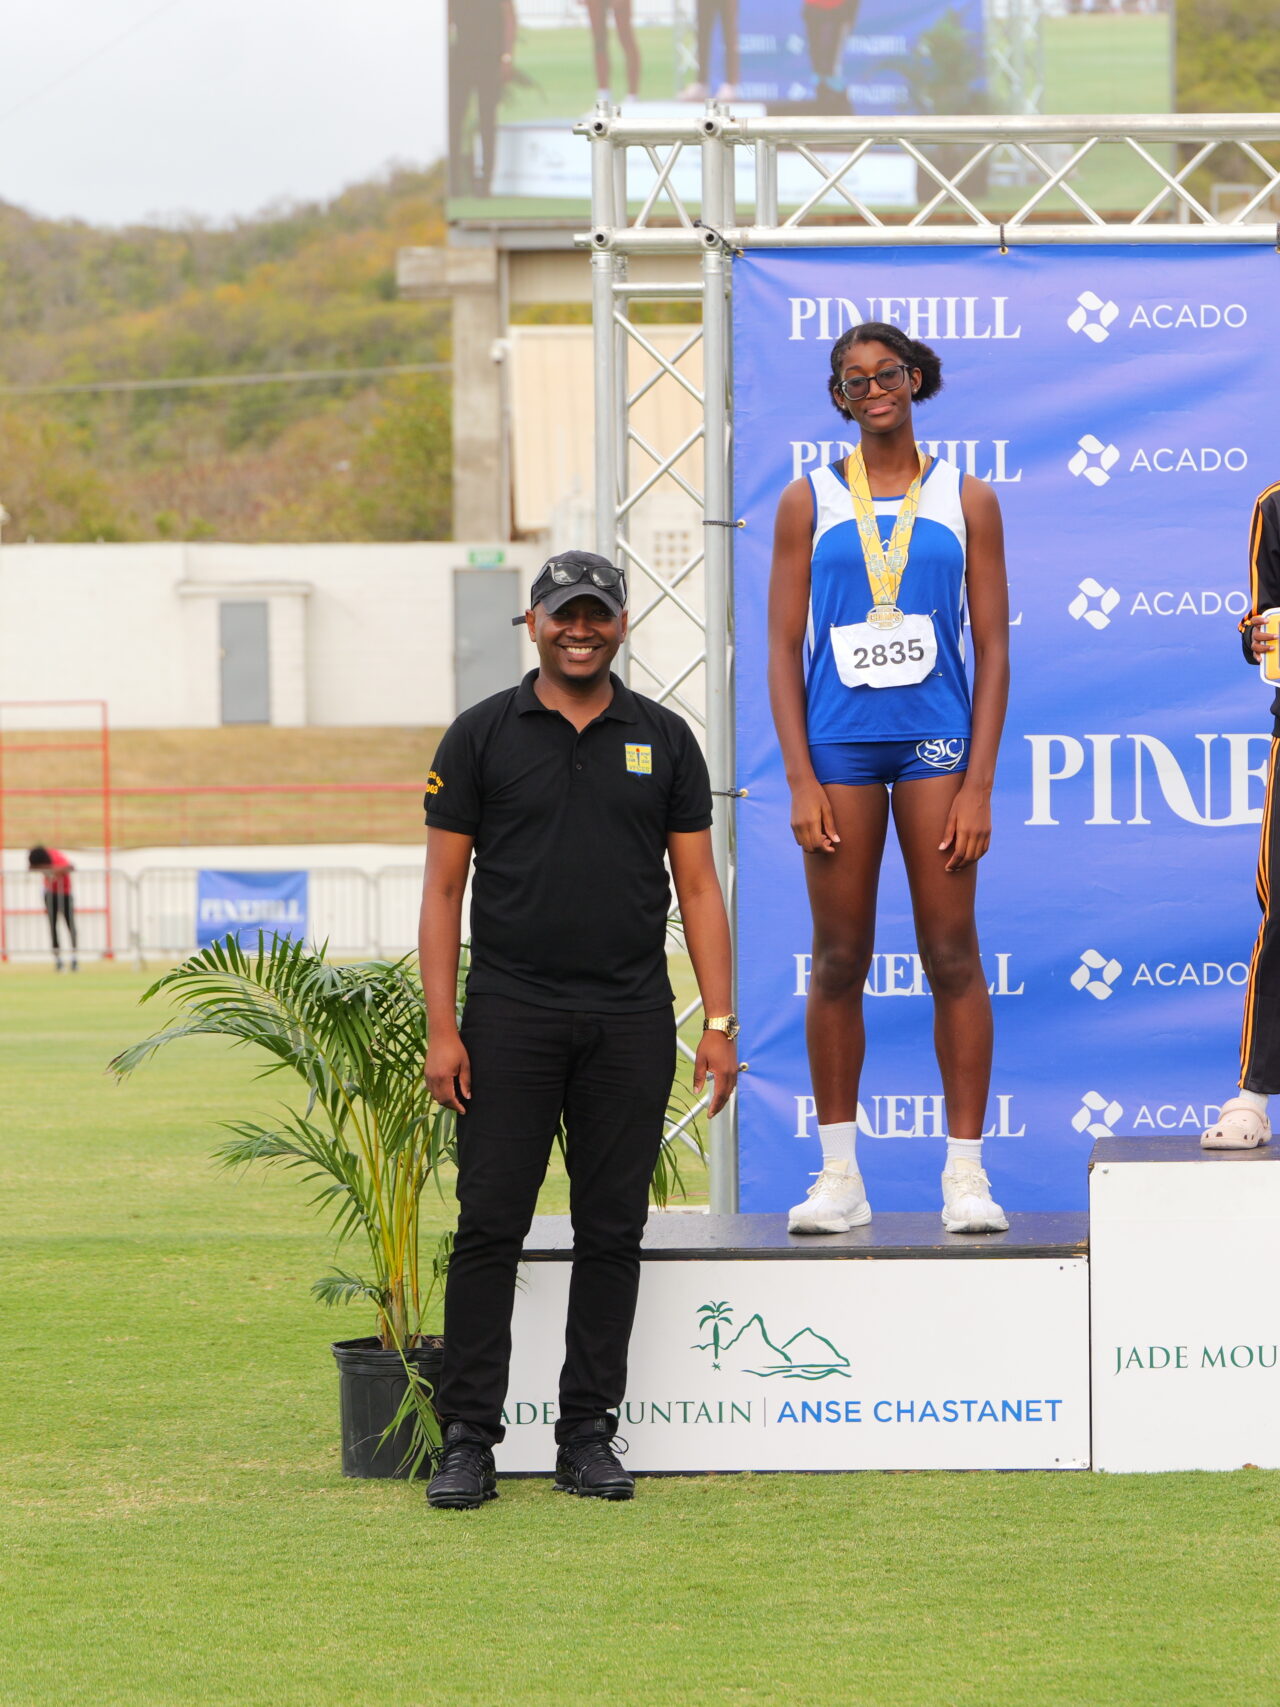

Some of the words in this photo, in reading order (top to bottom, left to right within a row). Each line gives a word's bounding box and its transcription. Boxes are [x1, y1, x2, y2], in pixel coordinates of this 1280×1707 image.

[1128, 303, 1248, 329] ACADO
[1129, 447, 1248, 472] ACADO
[1130, 591, 1248, 616] ACADO
[853, 638, 924, 669] 2835
[1132, 962, 1250, 986] ACADO
[1133, 1104, 1224, 1128] ACAD
[1114, 1346, 1188, 1375] JADE
[616, 1401, 752, 1425] UNTAIN
[777, 1400, 862, 1424] ANSE
[873, 1399, 1063, 1423] CHASTANET
